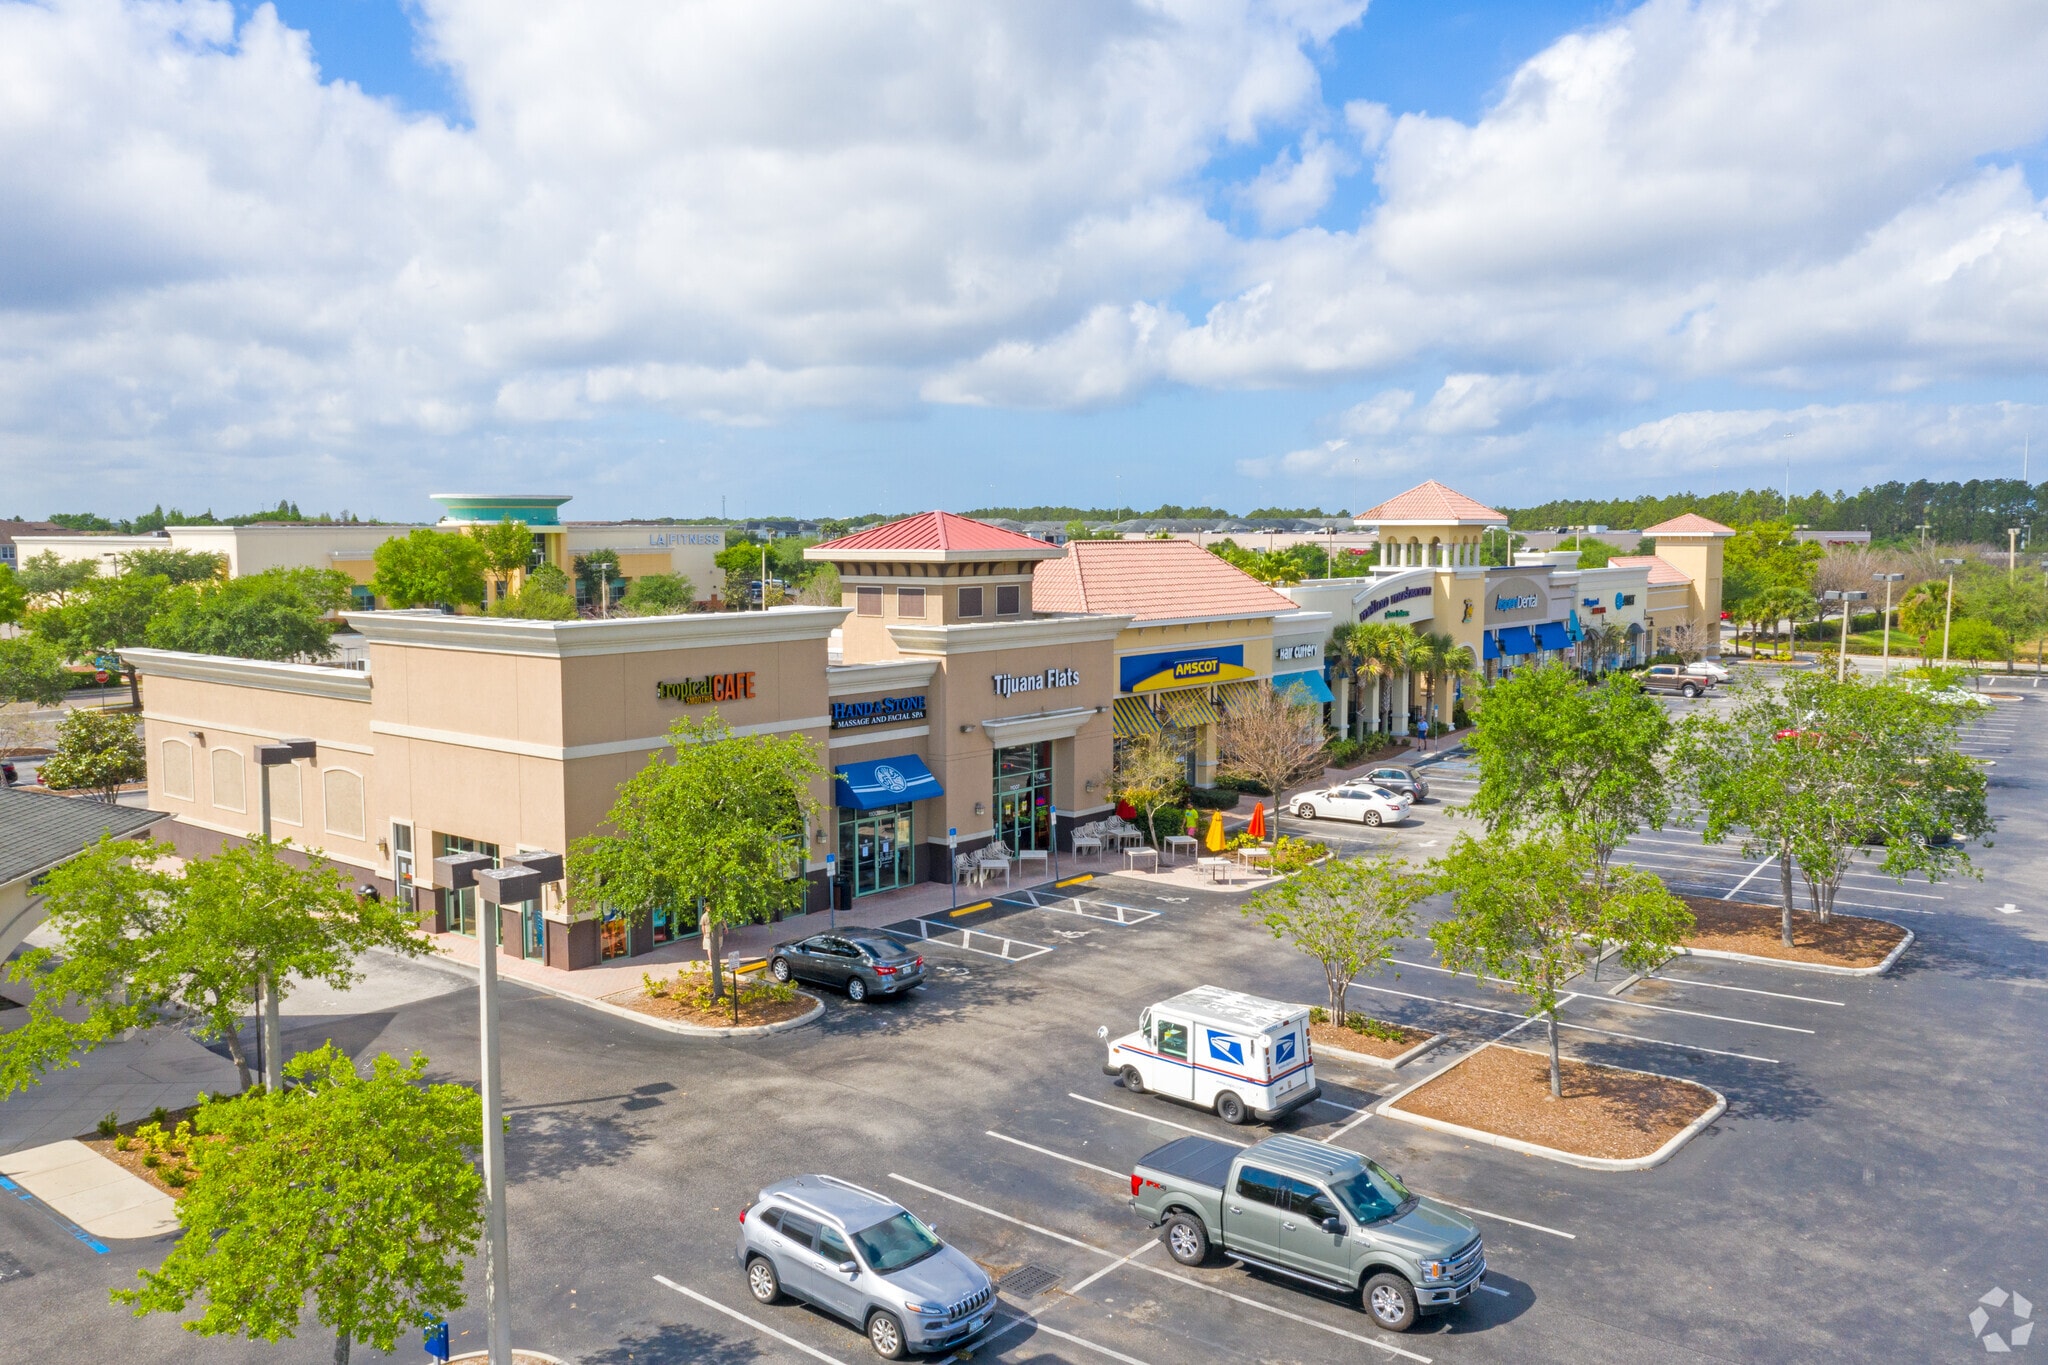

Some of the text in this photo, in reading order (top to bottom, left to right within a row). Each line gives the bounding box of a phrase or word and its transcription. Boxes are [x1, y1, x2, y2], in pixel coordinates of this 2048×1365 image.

[649, 533, 721, 546] LA FITNESS
[1175, 659, 1218, 676] AMSCOT
[656, 670, 756, 703] tropical CAFE
[993, 667, 1080, 699] Tijuana Flats
[685, 694, 713, 705] SMOOTHIE
[832, 695, 926, 720] HAND & STONE
[837, 710, 924, 729] MASSAGE AND FACIAL SPA
[1145, 1180, 1167, 1191] FX4
